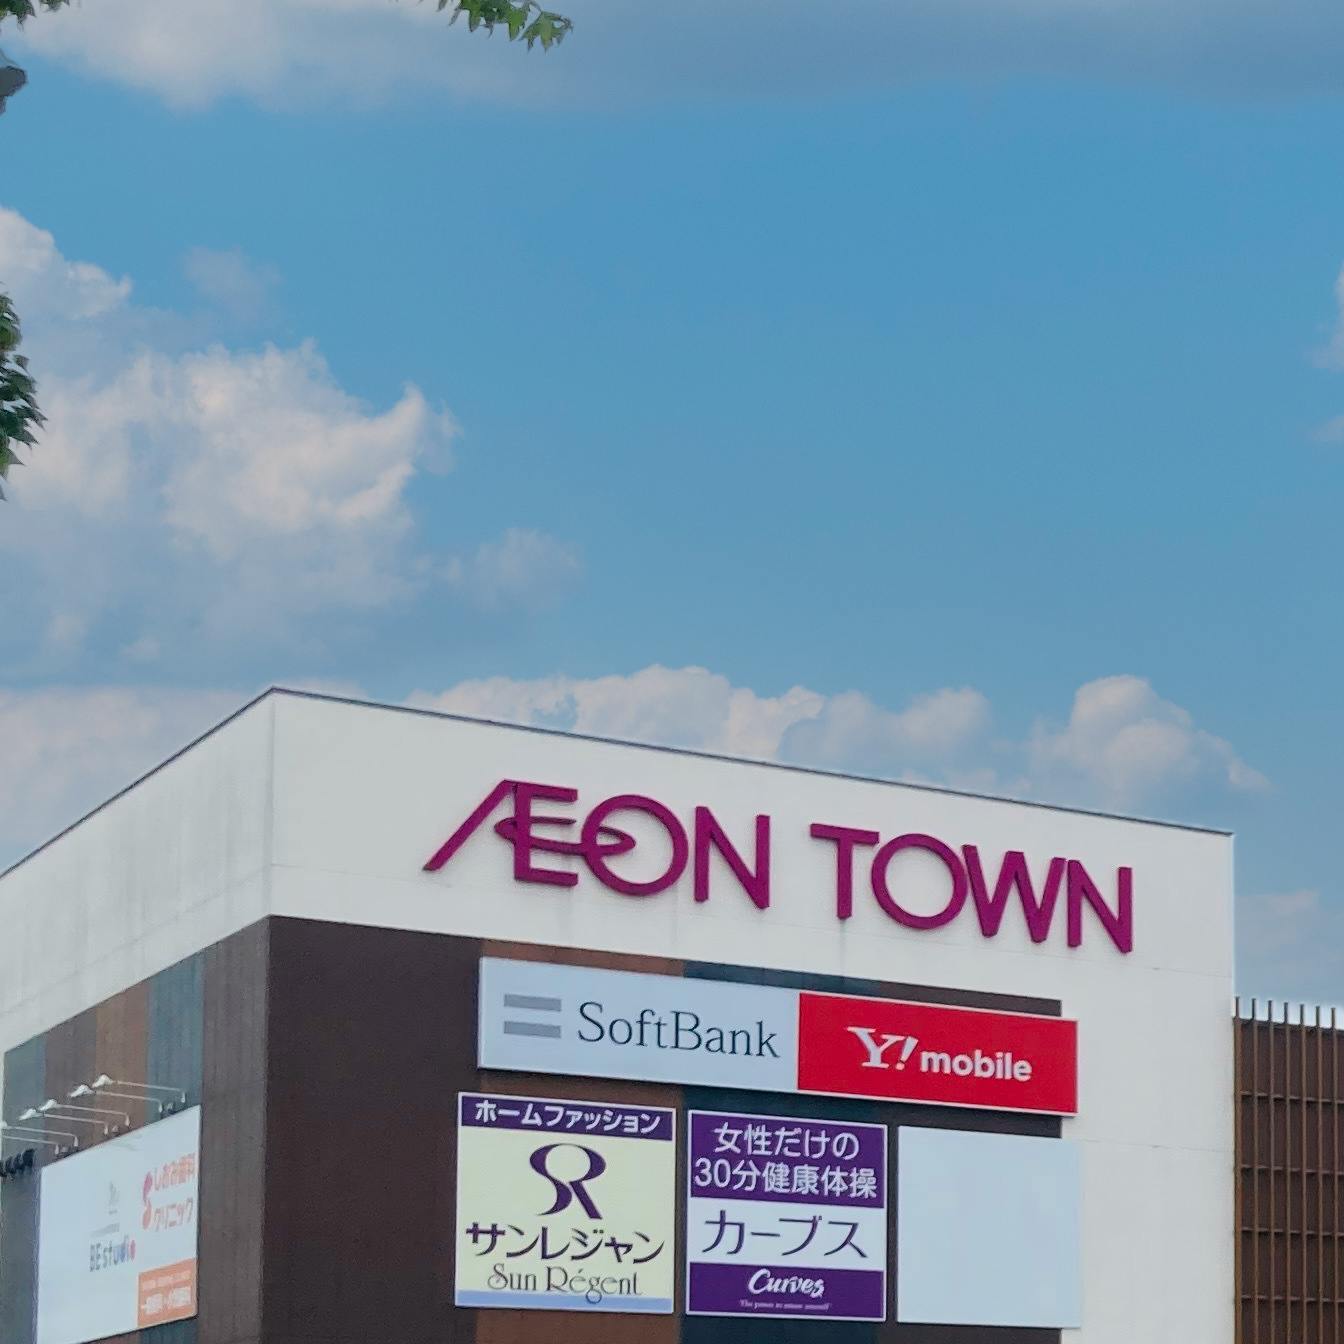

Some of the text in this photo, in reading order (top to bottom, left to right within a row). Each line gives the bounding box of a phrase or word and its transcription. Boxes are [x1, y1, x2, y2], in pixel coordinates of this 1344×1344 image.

[810, 823, 1133, 953] TOWN
[578, 1001, 780, 1060] SoftBank
[475, 1101, 661, 1135] ホームファッション
[712, 1122, 860, 1162] 女性だけの
[694, 1156, 878, 1200] 30分健康体操
[466, 1222, 665, 1265] サンレジャン
[704, 1211, 868, 1260] カーブス
[487, 1262, 538, 1293] Sun
[748, 1268, 825, 1298] Curves
